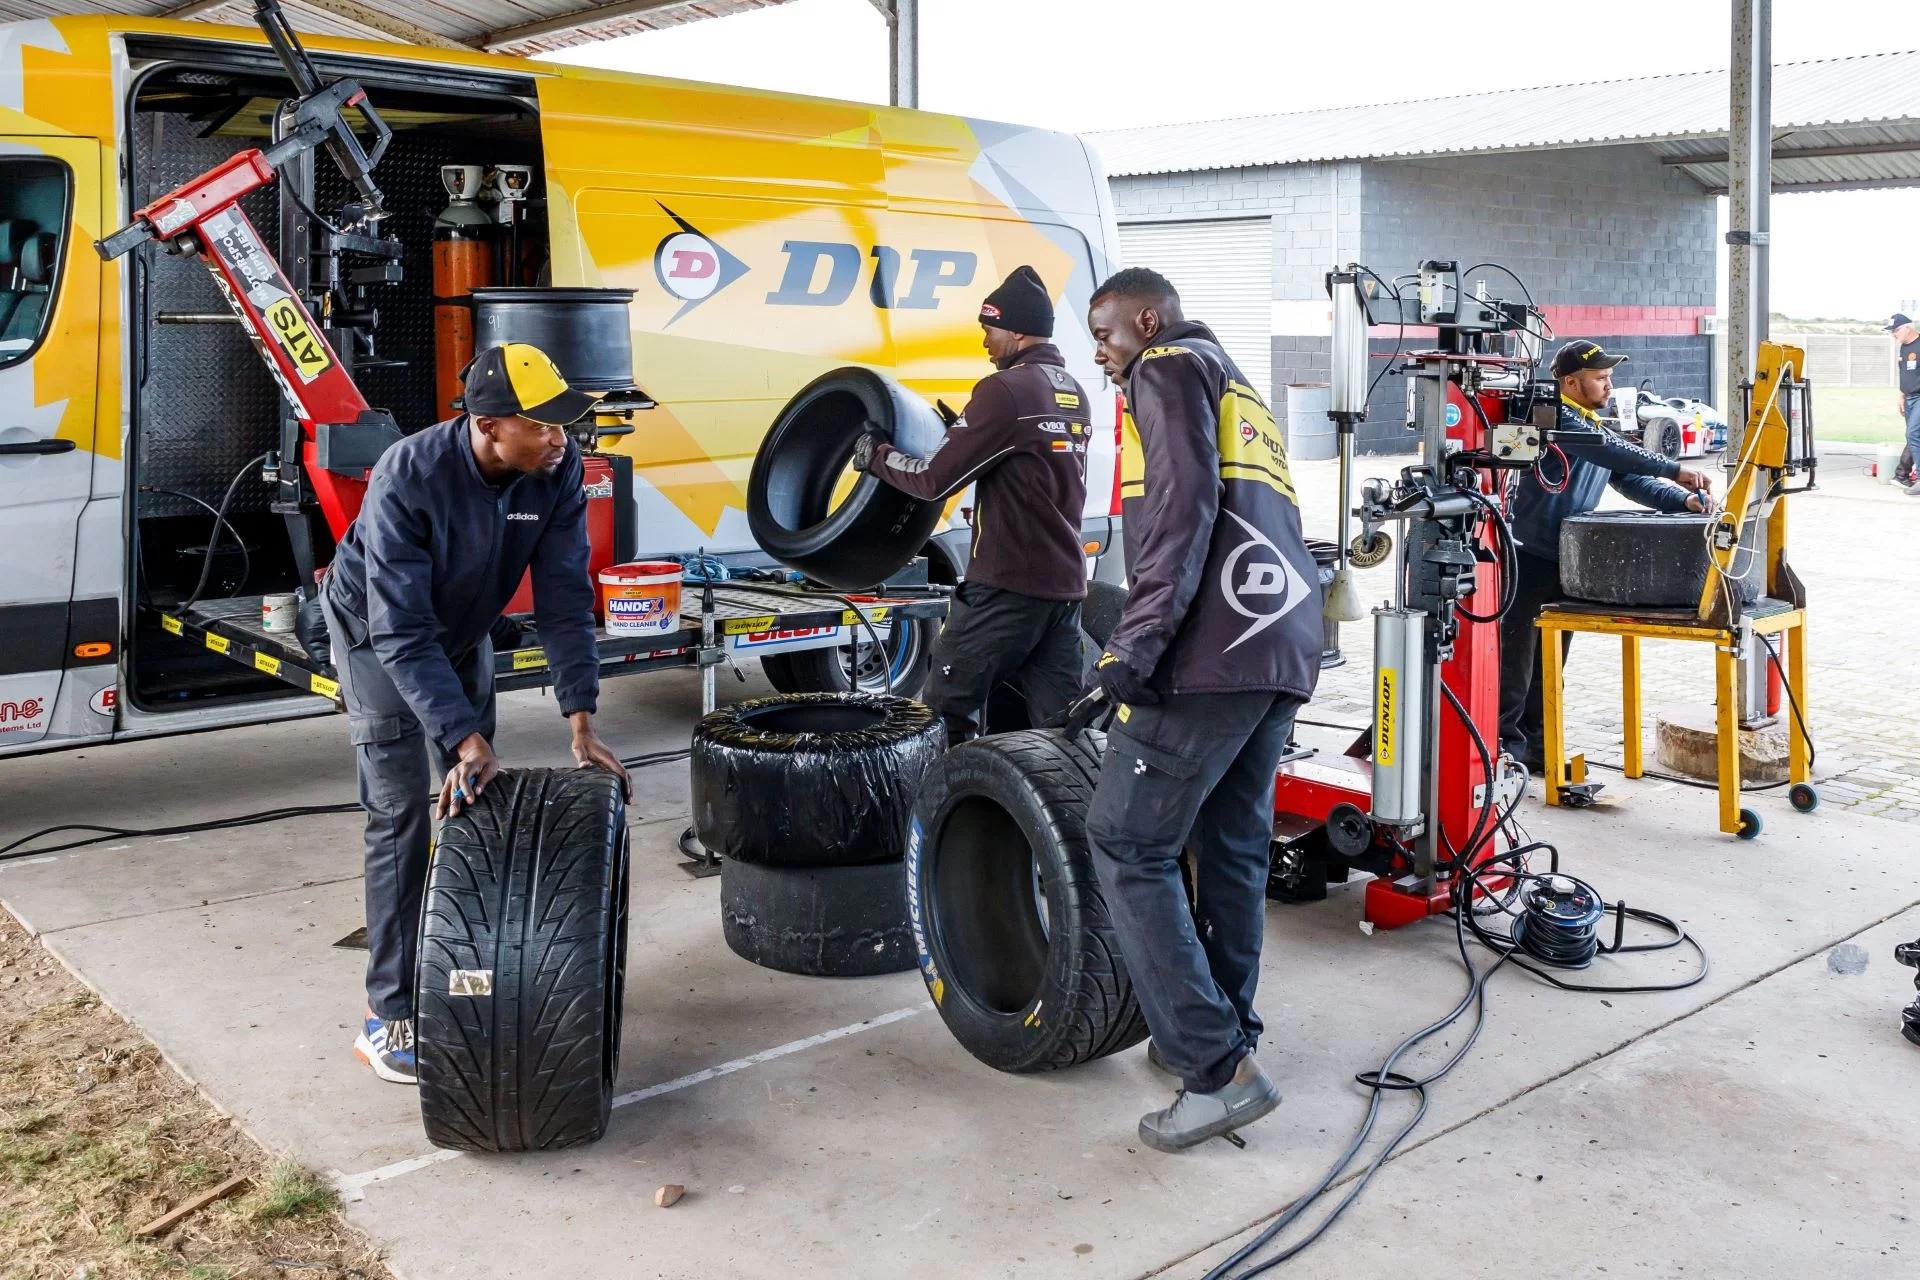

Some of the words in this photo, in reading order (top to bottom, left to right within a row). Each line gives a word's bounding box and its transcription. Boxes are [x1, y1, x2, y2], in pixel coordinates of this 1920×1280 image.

[273, 305, 324, 364] ATS
[506, 512, 540, 521] adidas
[1236, 562, 1285, 594] D
[609, 598, 662, 613] HANDEX
[734, 621, 769, 630] DUNLOP
[1381, 676, 1391, 747] DUNLOP
[907, 827, 928, 955] MICHELIN
